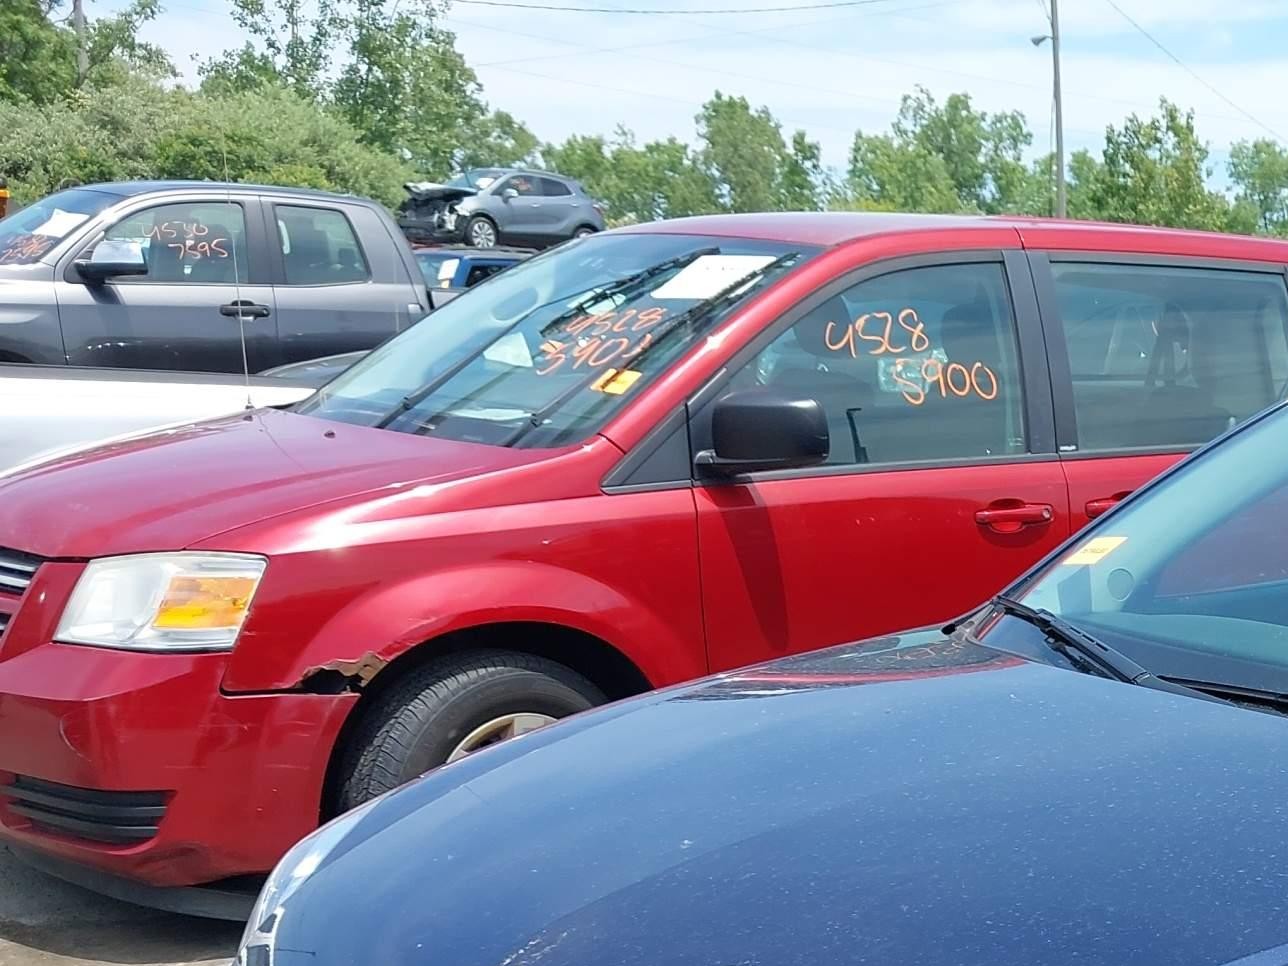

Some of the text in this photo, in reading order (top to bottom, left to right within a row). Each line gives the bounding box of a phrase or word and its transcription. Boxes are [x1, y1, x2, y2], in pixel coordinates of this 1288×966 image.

[566, 307, 667, 336] 4528
[825, 308, 929, 358] 4528
[892, 358, 998, 405] 5900
